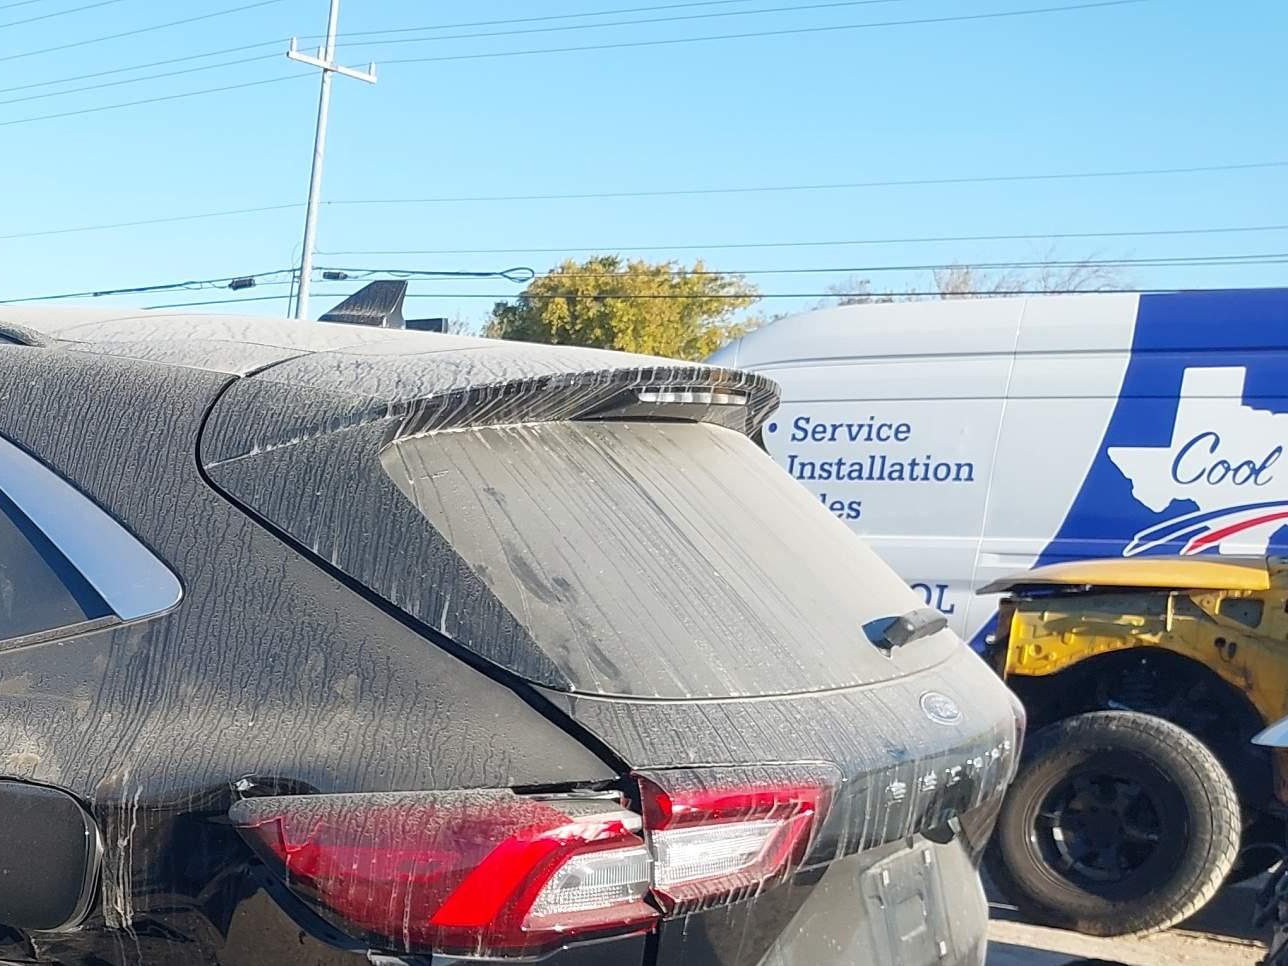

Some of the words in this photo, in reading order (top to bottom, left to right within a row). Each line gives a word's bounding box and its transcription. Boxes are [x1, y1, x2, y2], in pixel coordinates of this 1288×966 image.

[790, 416, 912, 442] Service
[787, 455, 975, 482] Installation
[1171, 431, 1283, 486] Cool
